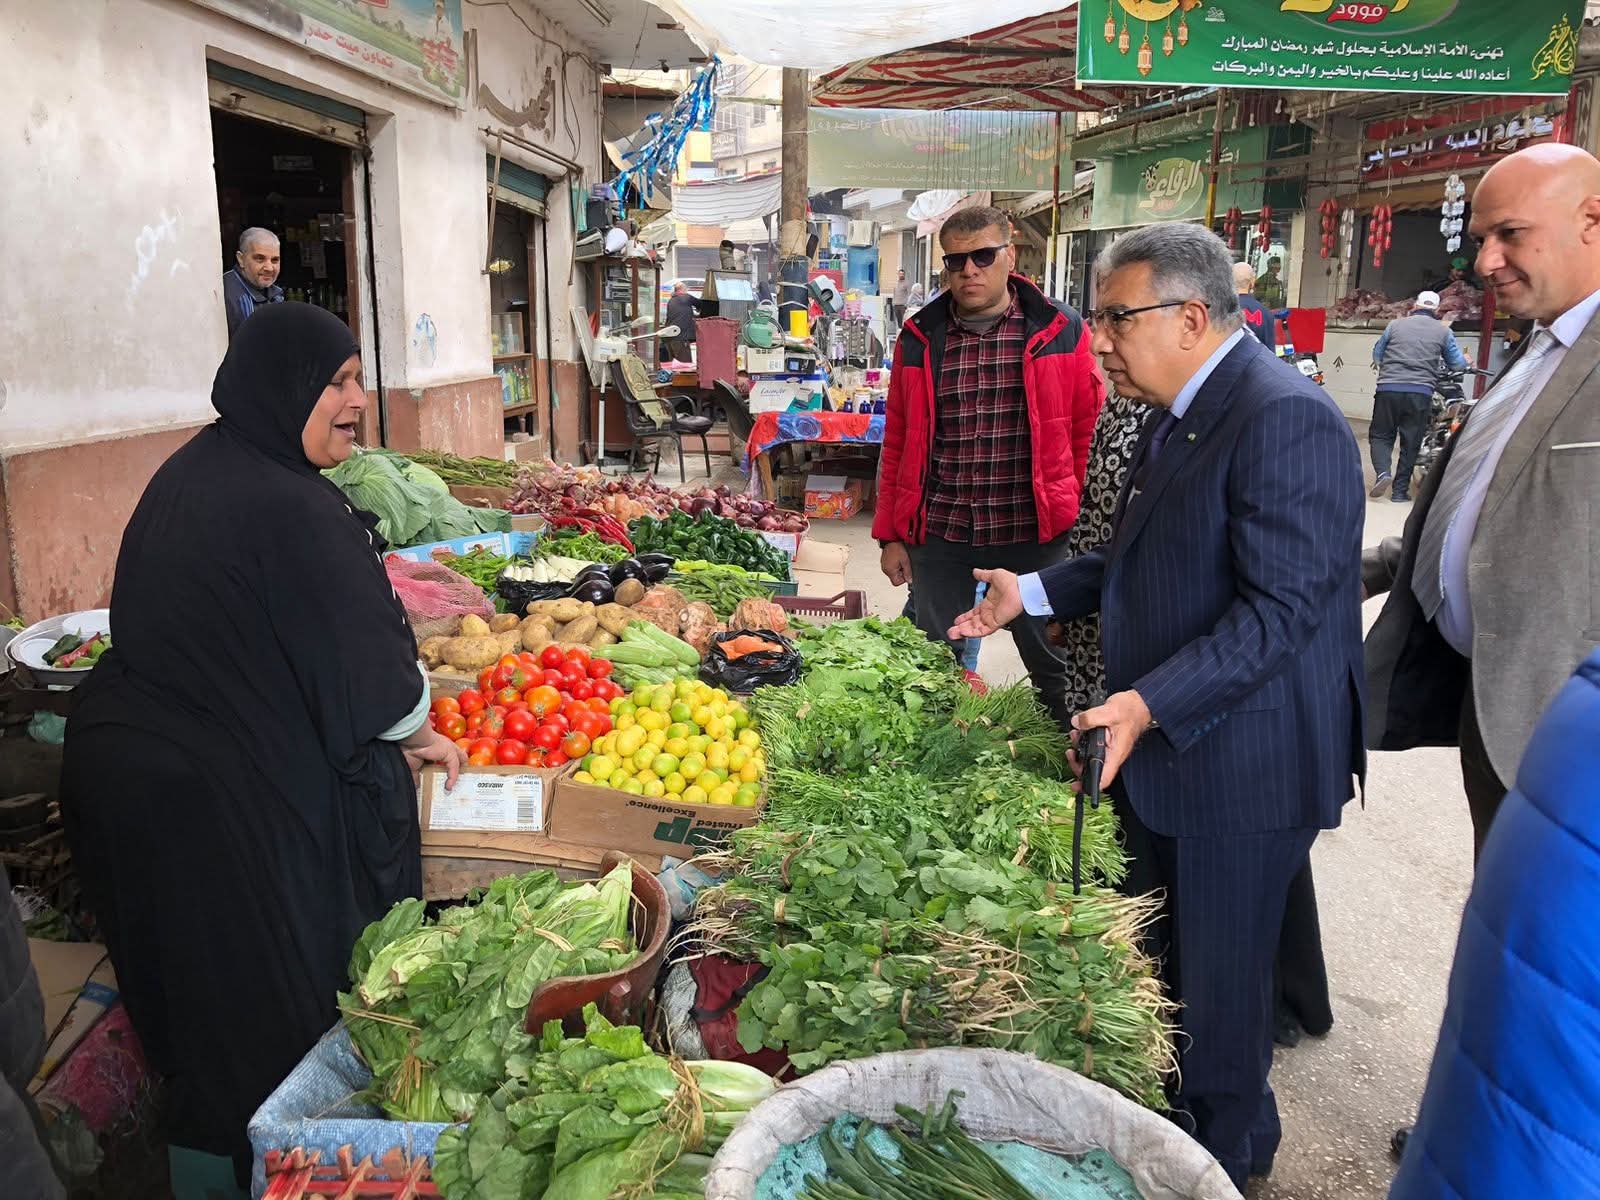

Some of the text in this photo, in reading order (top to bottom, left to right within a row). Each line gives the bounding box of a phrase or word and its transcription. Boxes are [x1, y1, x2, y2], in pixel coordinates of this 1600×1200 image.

[1336, 3, 1383, 19] فوود
[335, 35, 360, 56] ميت
[1221, 36, 1268, 52] المبارك
[1271, 38, 1308, 55] رمضان
[1311, 40, 1334, 55] شهر
[1336, 41, 1376, 57] بحلول
[361, 47, 394, 69] تعاون
[1212, 60, 1275, 77] والبركات
[1277, 63, 1316, 78] واليمن
[1319, 64, 1362, 80] بالخير
[1421, 67, 1453, 82] علينا
[1456, 68, 1477, 80] الله
[1479, 66, 1510, 81] أعاده
[477, 781, 504, 789] MIRASCO
[627, 800, 697, 819] Excellence
[696, 819, 743, 830] Trusted
